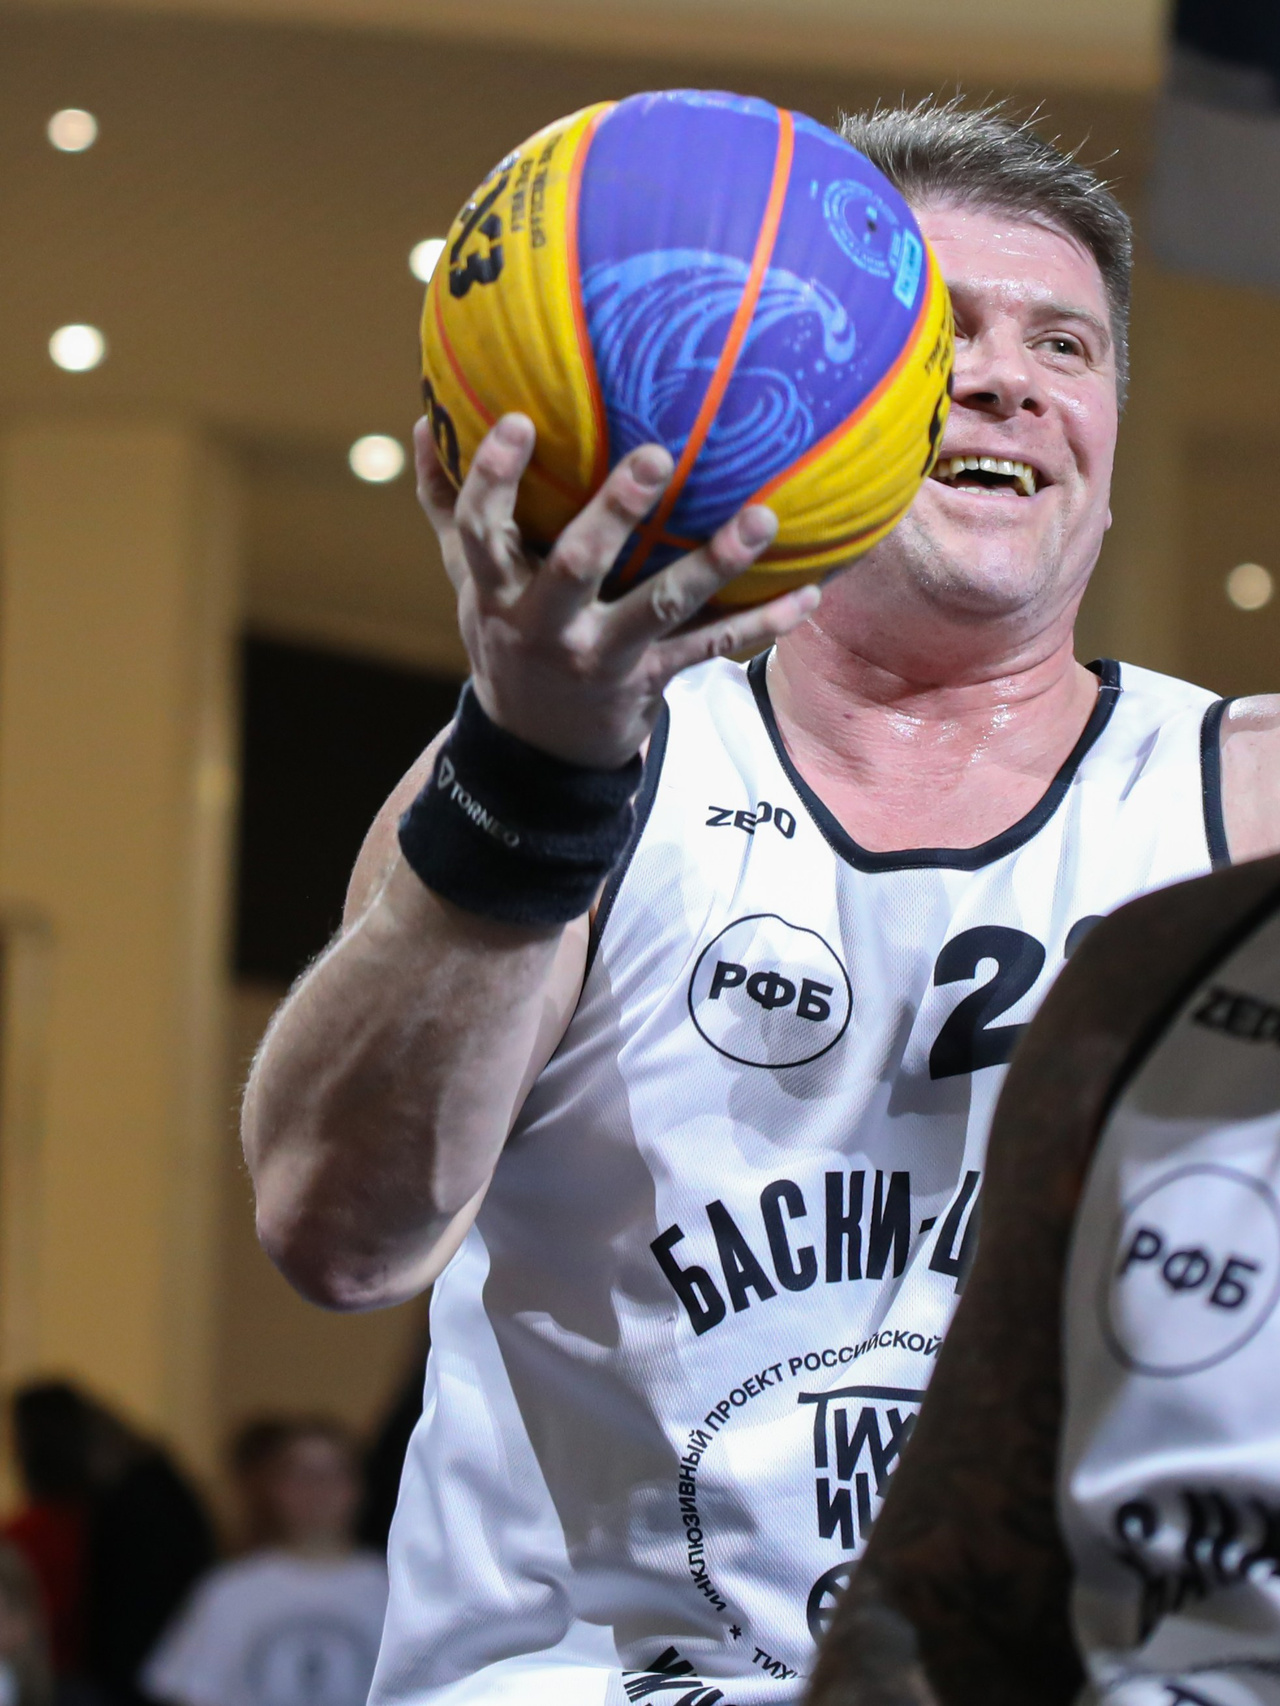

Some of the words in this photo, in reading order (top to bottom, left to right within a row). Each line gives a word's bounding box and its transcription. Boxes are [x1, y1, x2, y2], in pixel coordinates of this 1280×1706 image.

[708, 961, 834, 1023] РФБ
[928, 914, 1108, 1080] 2
[1117, 1227, 1260, 1312] РФБ
[679, 1429, 727, 1612] ИНКЛЮЗИВНЫЙ
[704, 1363, 784, 1432] ПРОЕКТ
[788, 1330, 943, 1377] РОССИЙСКОЙ
